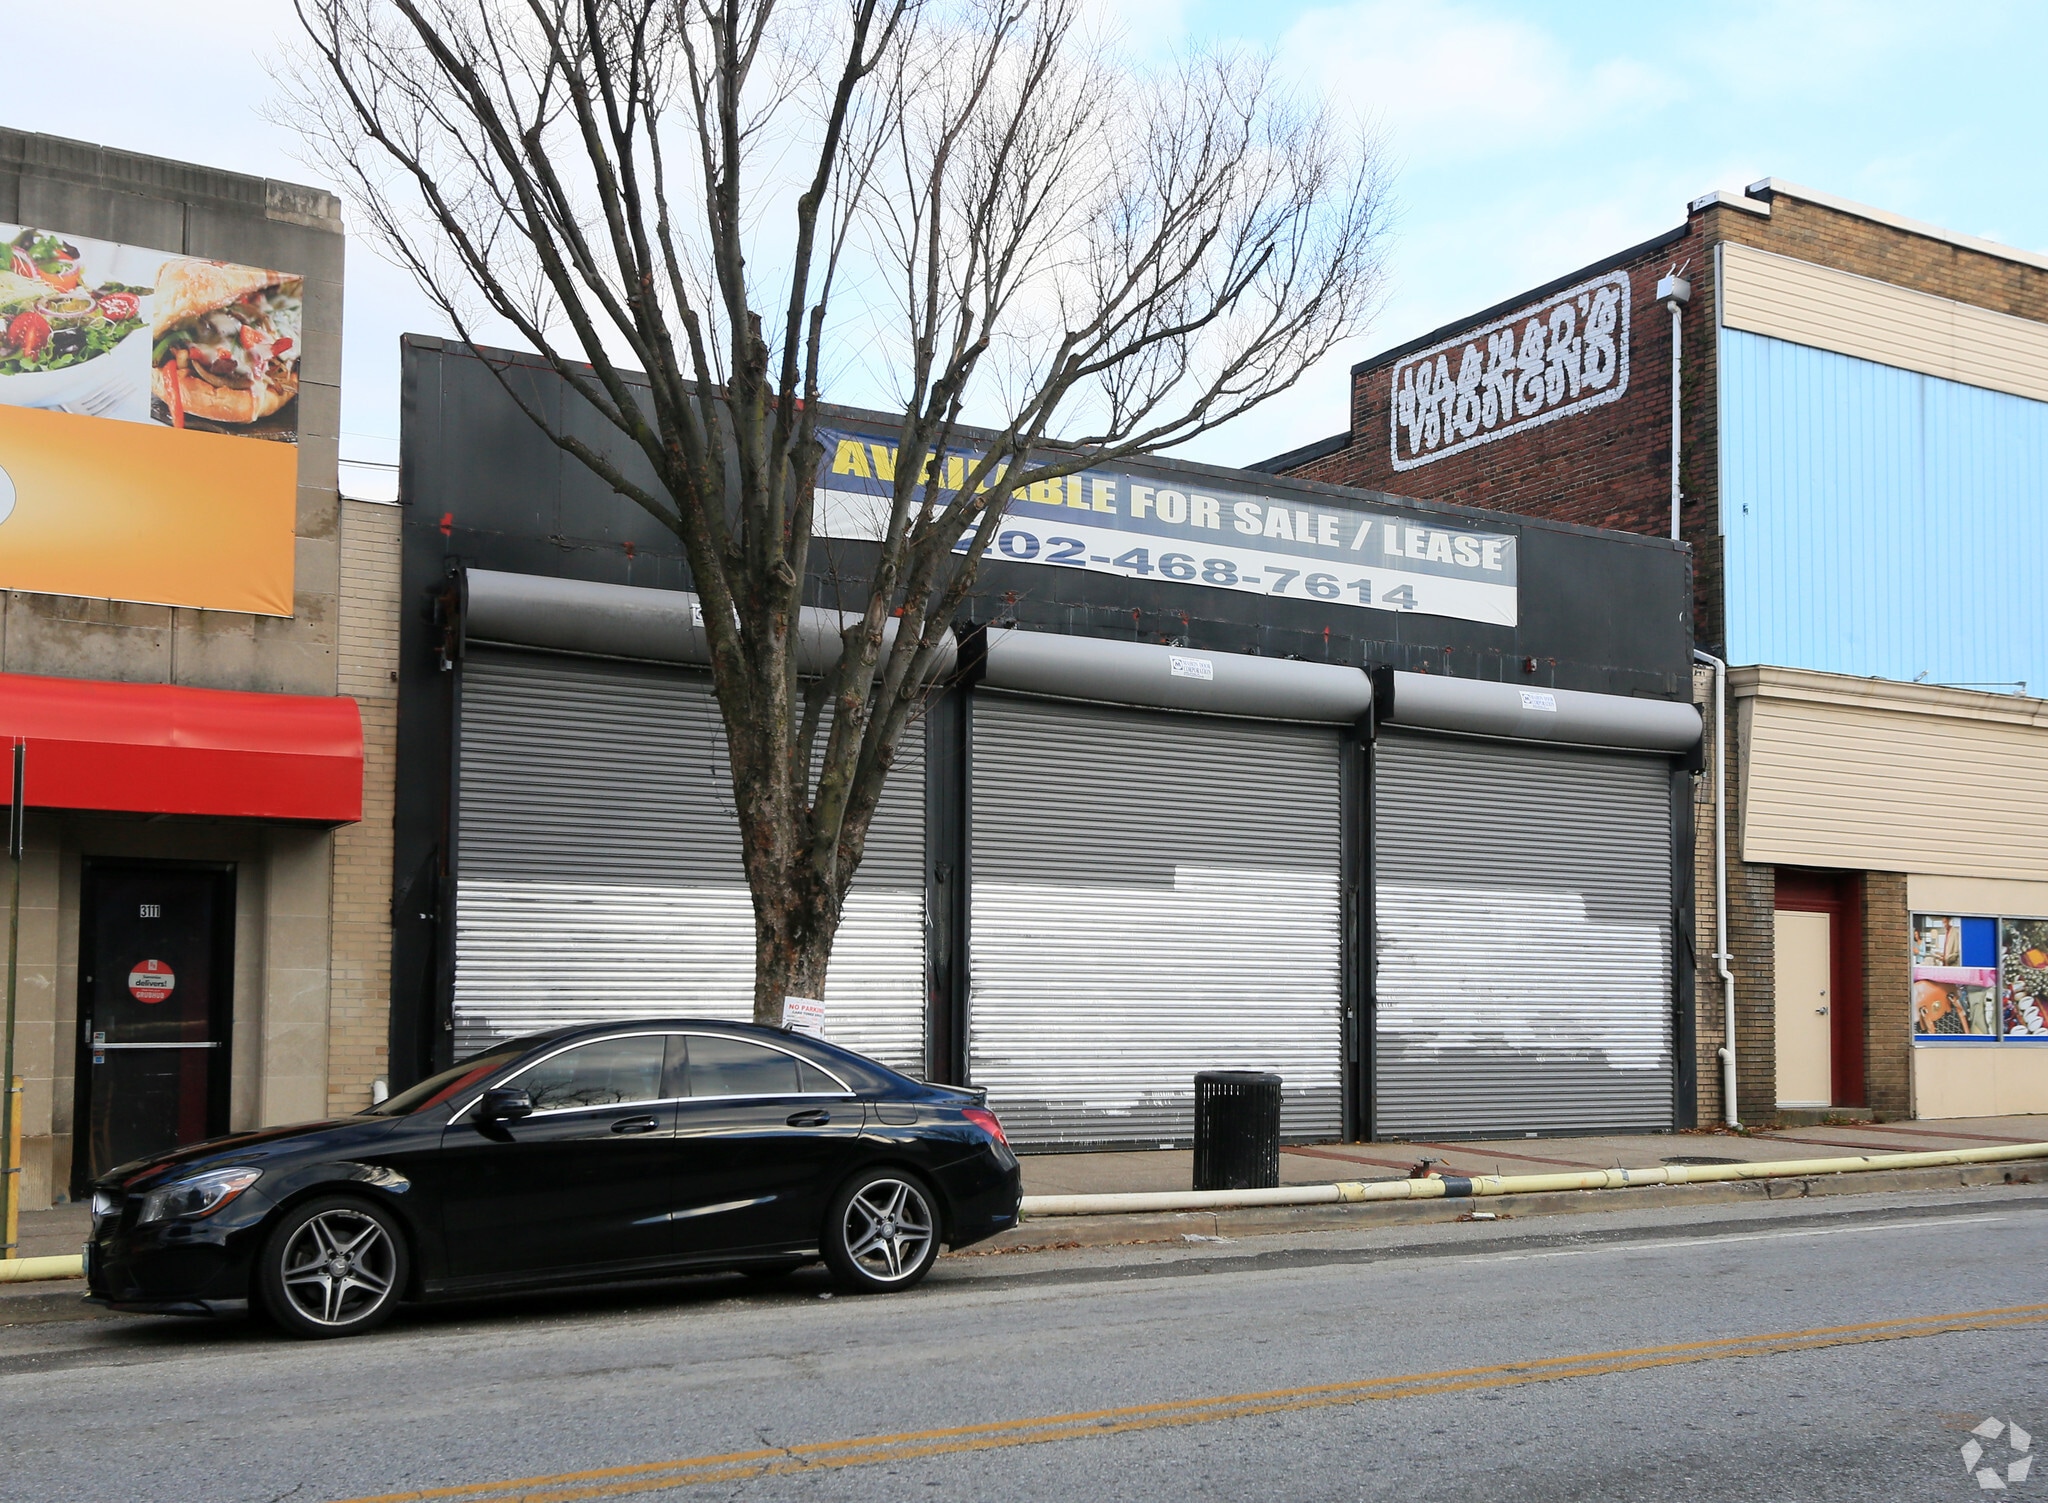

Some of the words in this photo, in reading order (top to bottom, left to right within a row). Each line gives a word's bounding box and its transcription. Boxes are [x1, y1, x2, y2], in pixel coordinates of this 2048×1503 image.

[1130, 484, 1220, 530] FOR
[1233, 502, 1340, 548] SALE
[1350, 521, 1373, 551] /
[1384, 524, 1503, 571] LEASE
[140, 905, 160, 917] 3111
[135, 979, 167, 987] delivers!
